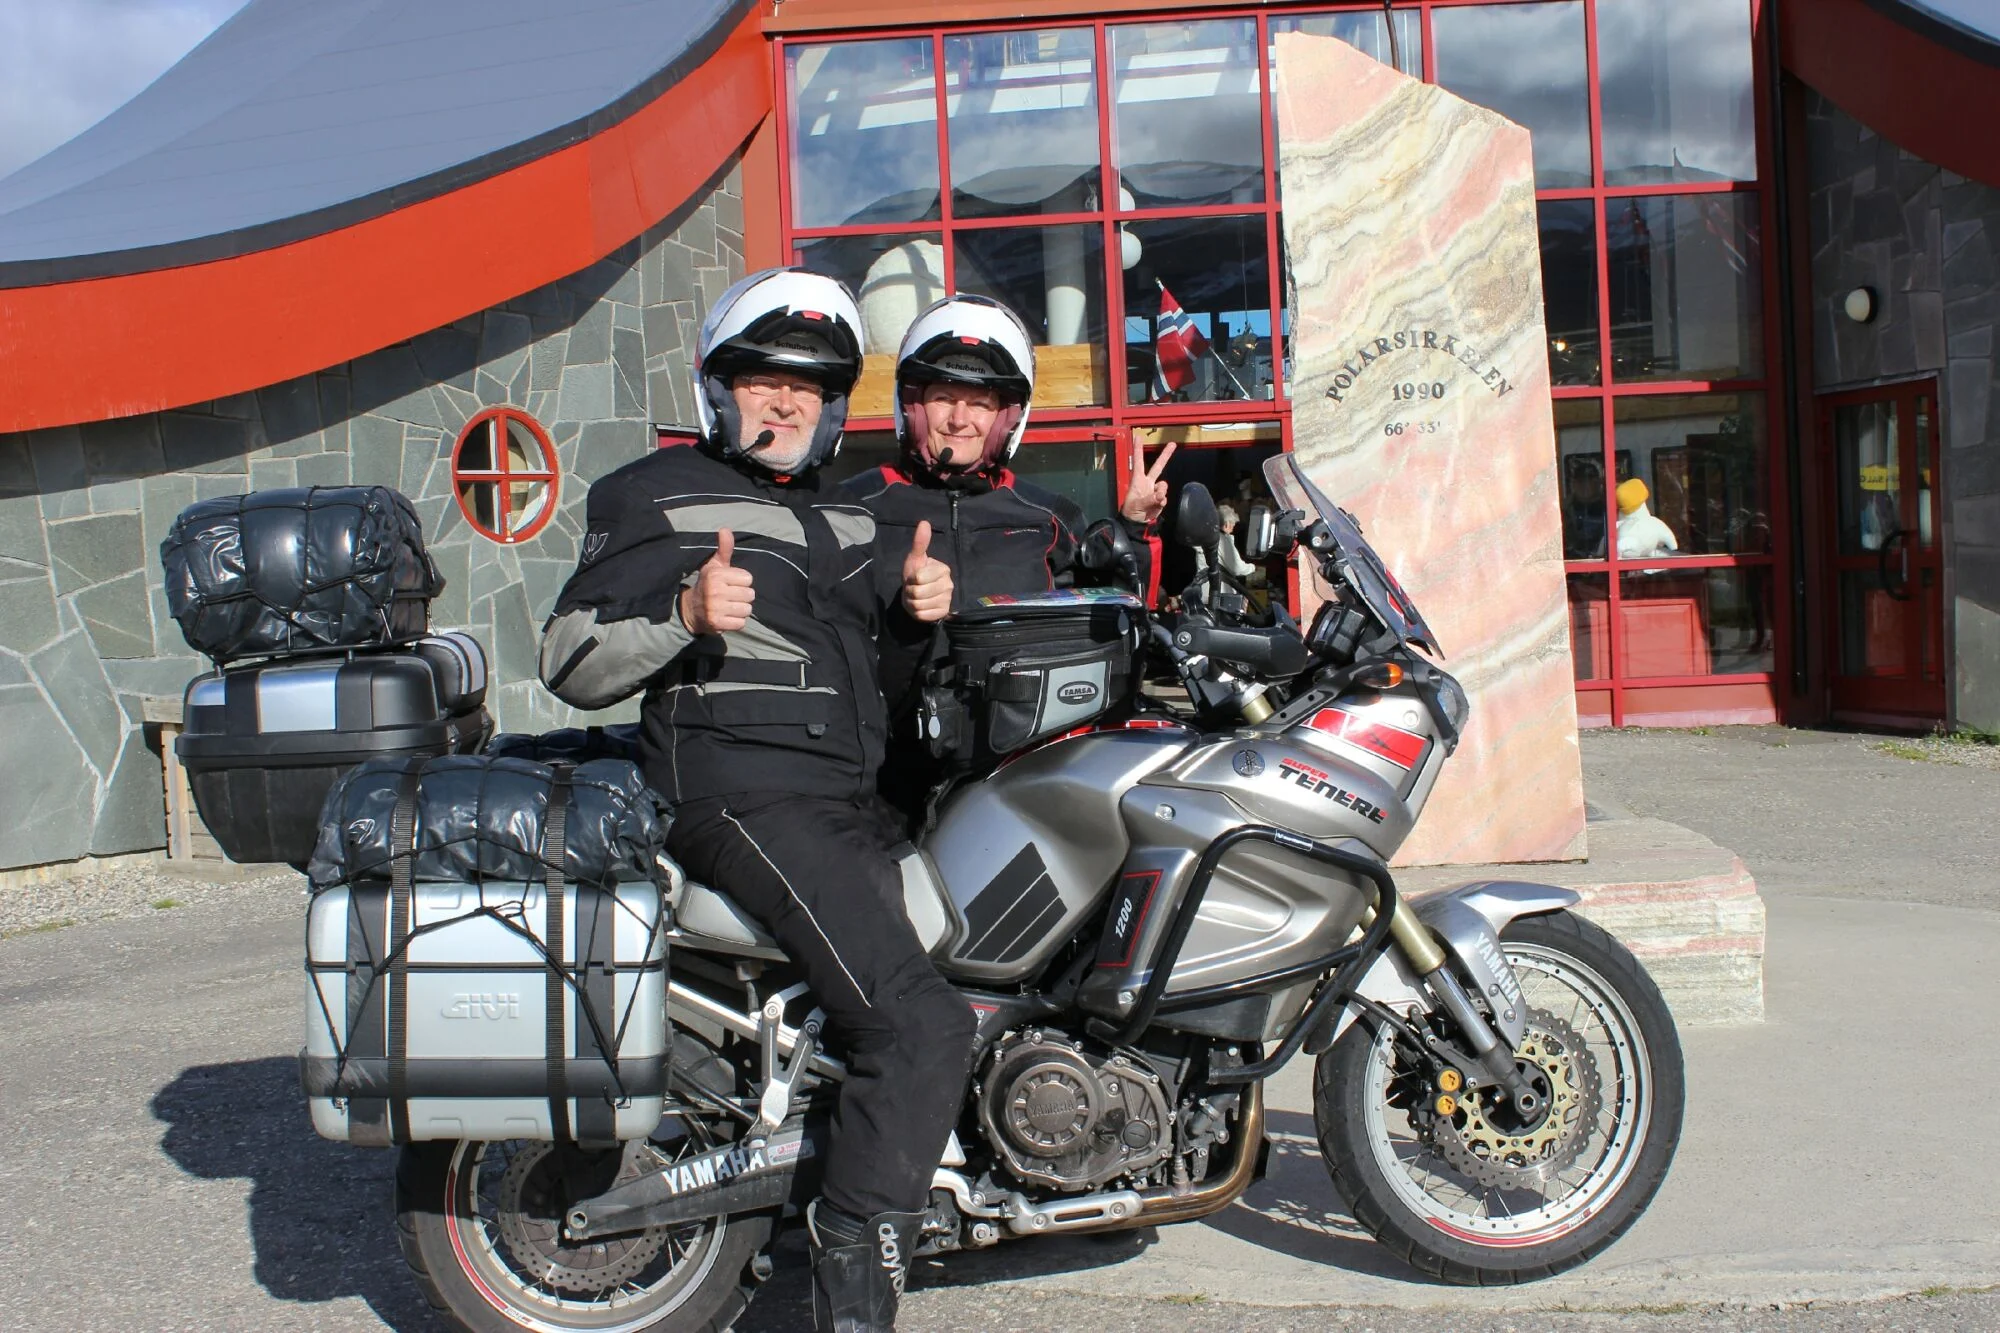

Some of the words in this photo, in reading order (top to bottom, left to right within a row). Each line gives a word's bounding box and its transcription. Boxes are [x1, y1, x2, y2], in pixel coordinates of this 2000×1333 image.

[774, 340, 818, 354] Schuberth
[945, 361, 986, 375] Schuberth
[1325, 330, 1514, 403] POLARSIRKELEN
[1392, 382, 1445, 401] 1990
[1064, 687, 1093, 696] FAMSA
[1281, 757, 1329, 780] SUPER
[1115, 897, 1133, 938] 1200
[1474, 931, 1521, 1005] YAMAHA
[441, 992, 520, 1020] GIVI
[1030, 1099, 1076, 1117] YAMAHA
[661, 1148, 766, 1195] YAMAHA
